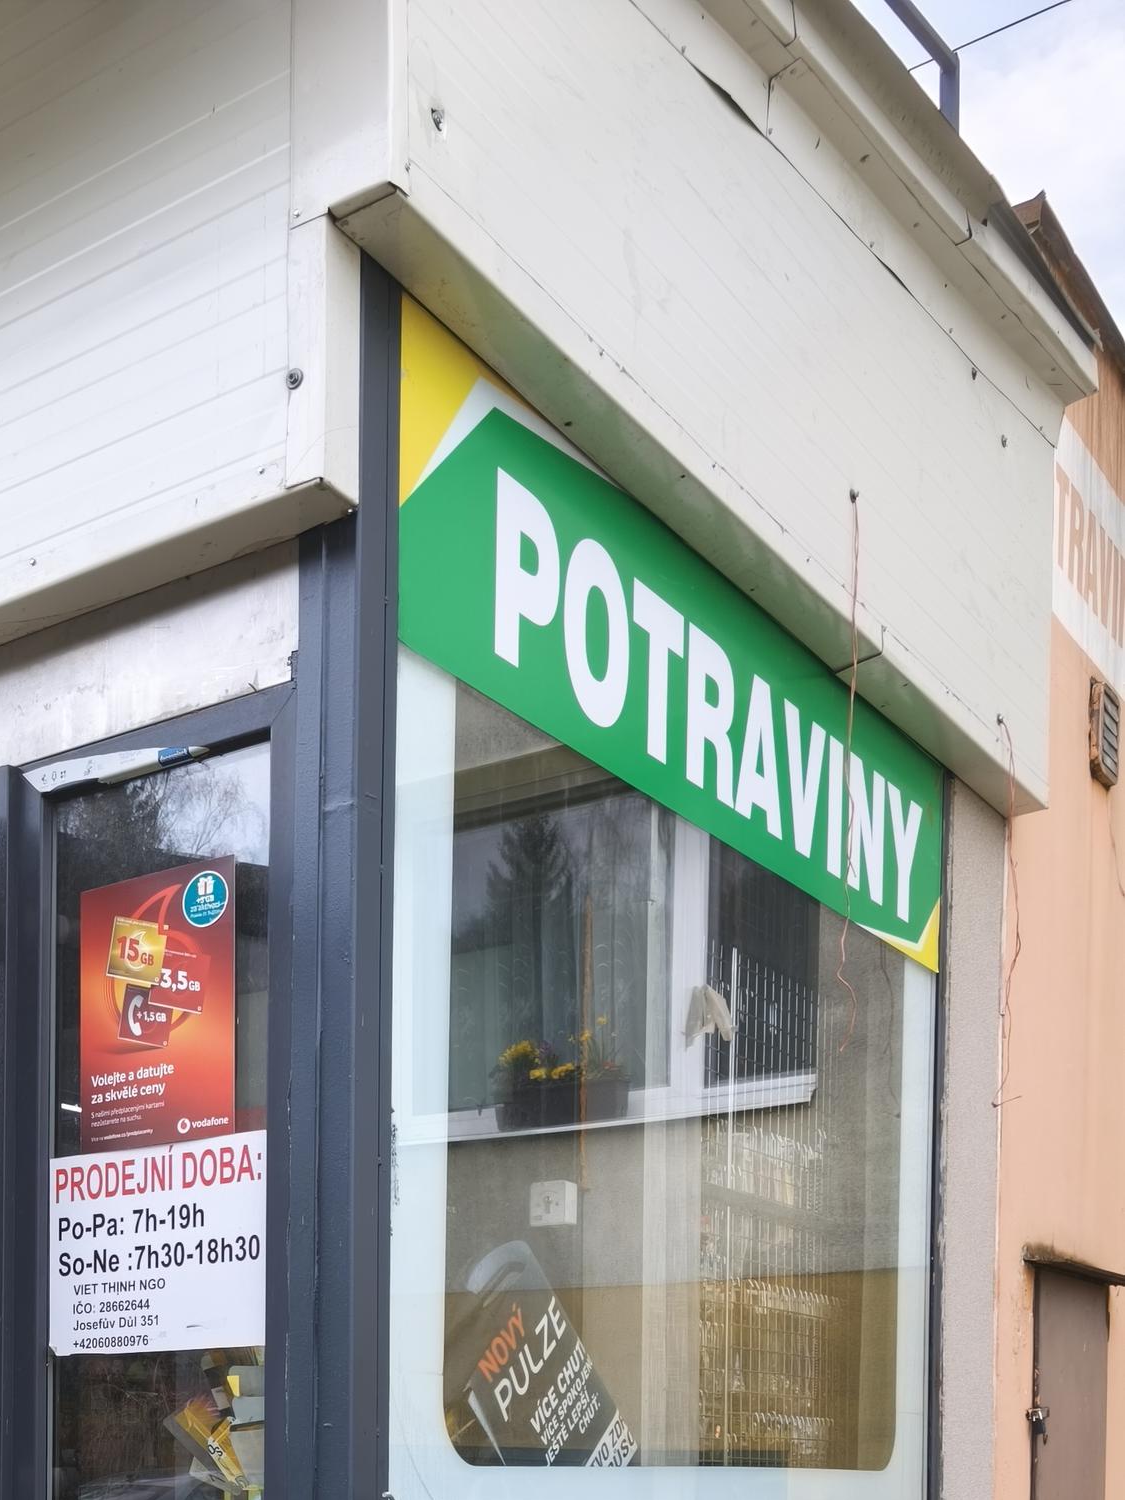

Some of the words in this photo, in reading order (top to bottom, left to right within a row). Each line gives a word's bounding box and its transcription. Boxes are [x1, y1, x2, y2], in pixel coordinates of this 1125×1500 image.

[494, 466, 923, 923] POTRAVINY
[117, 936, 140, 962] 15
[141, 952, 155, 966] GB
[160, 968, 188, 992] 3,5
[188, 980, 201, 991] GB
[156, 1012, 167, 1022] GB
[91, 1071, 126, 1087] Volejte
[128, 1071, 135, 1080] a
[136, 1063, 175, 1079] datujte
[91, 1093, 103, 1105] za
[105, 1083, 138, 1102] skvělé
[140, 1082, 166, 1097] ceny
[191, 1116, 229, 1129] vodafone
[55, 1144, 174, 1204] PRODEJNÍ
[181, 1144, 262, 1190] DOBA:
[58, 1212, 125, 1242] Po-Pa:
[132, 1202, 205, 1234] 7h-19h
[58, 1248, 120, 1277] So-Ne
[73, 1283, 98, 1296] VIET
[139, 1277, 166, 1291] NGO
[72, 1300, 96, 1315] IČO:
[99, 1297, 150, 1313] 28662644
[73, 1317, 116, 1331] Josefův
[118, 1315, 137, 1328] Důl
[140, 1314, 159, 1327] 351
[73, 1334, 149, 1349] +42060880976
[477, 1302, 525, 1383] NOVÝ
[494, 1295, 567, 1422] PULZE
[530, 1385, 559, 1433] VÍCE
[578, 1392, 601, 1434] CHUŤ.
[540, 1415, 560, 1445] VÍCE
[545, 1423, 569, 1467] JEŠTĚ
[567, 1385, 590, 1431] LEPŠÍ
